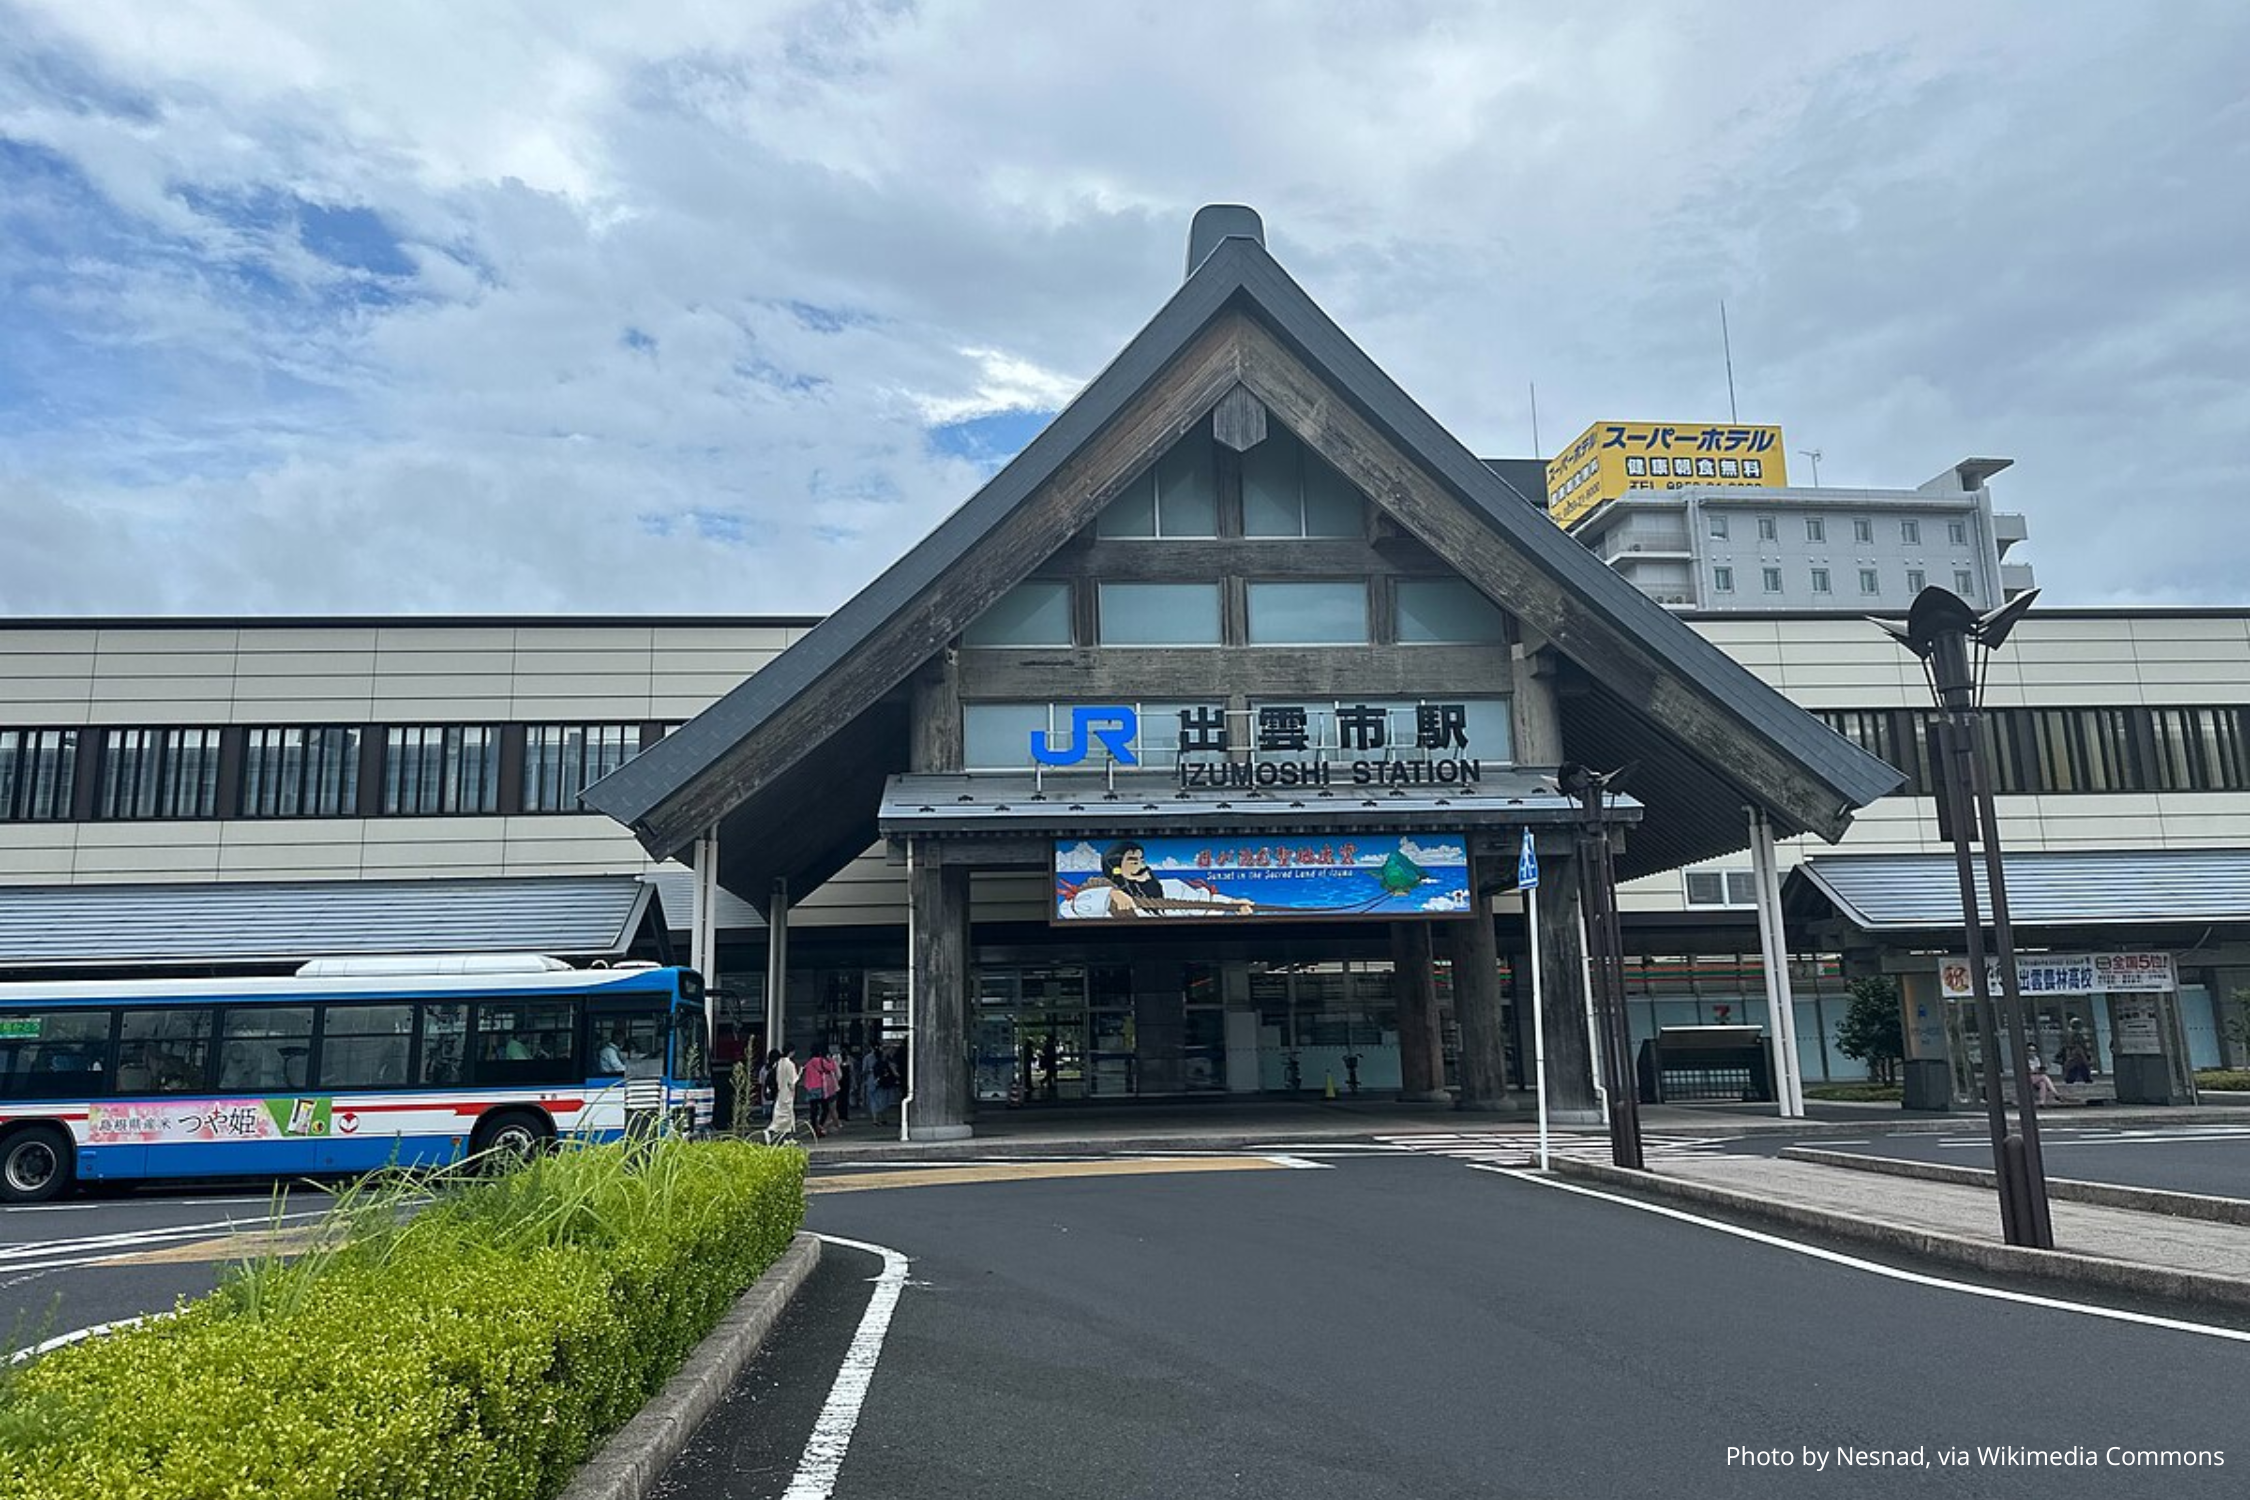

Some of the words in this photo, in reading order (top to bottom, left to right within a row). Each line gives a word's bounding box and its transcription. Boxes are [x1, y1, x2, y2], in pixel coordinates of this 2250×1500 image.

[1602, 427, 1776, 452] スーパーホテル
[1625, 456, 1762, 479] 健康朝食無料
[1031, 707, 1138, 765] JR
[1180, 705, 1468, 752] 出雲市駅
[1181, 763, 1329, 786] IZUMOSHI
[1352, 759, 1480, 784] STATION
[1265, 870, 1293, 880] Sacred
[1295, 869, 1315, 879] Land
[1943, 965, 1970, 992] 祝
[178, 1106, 256, 1136] つや姫
